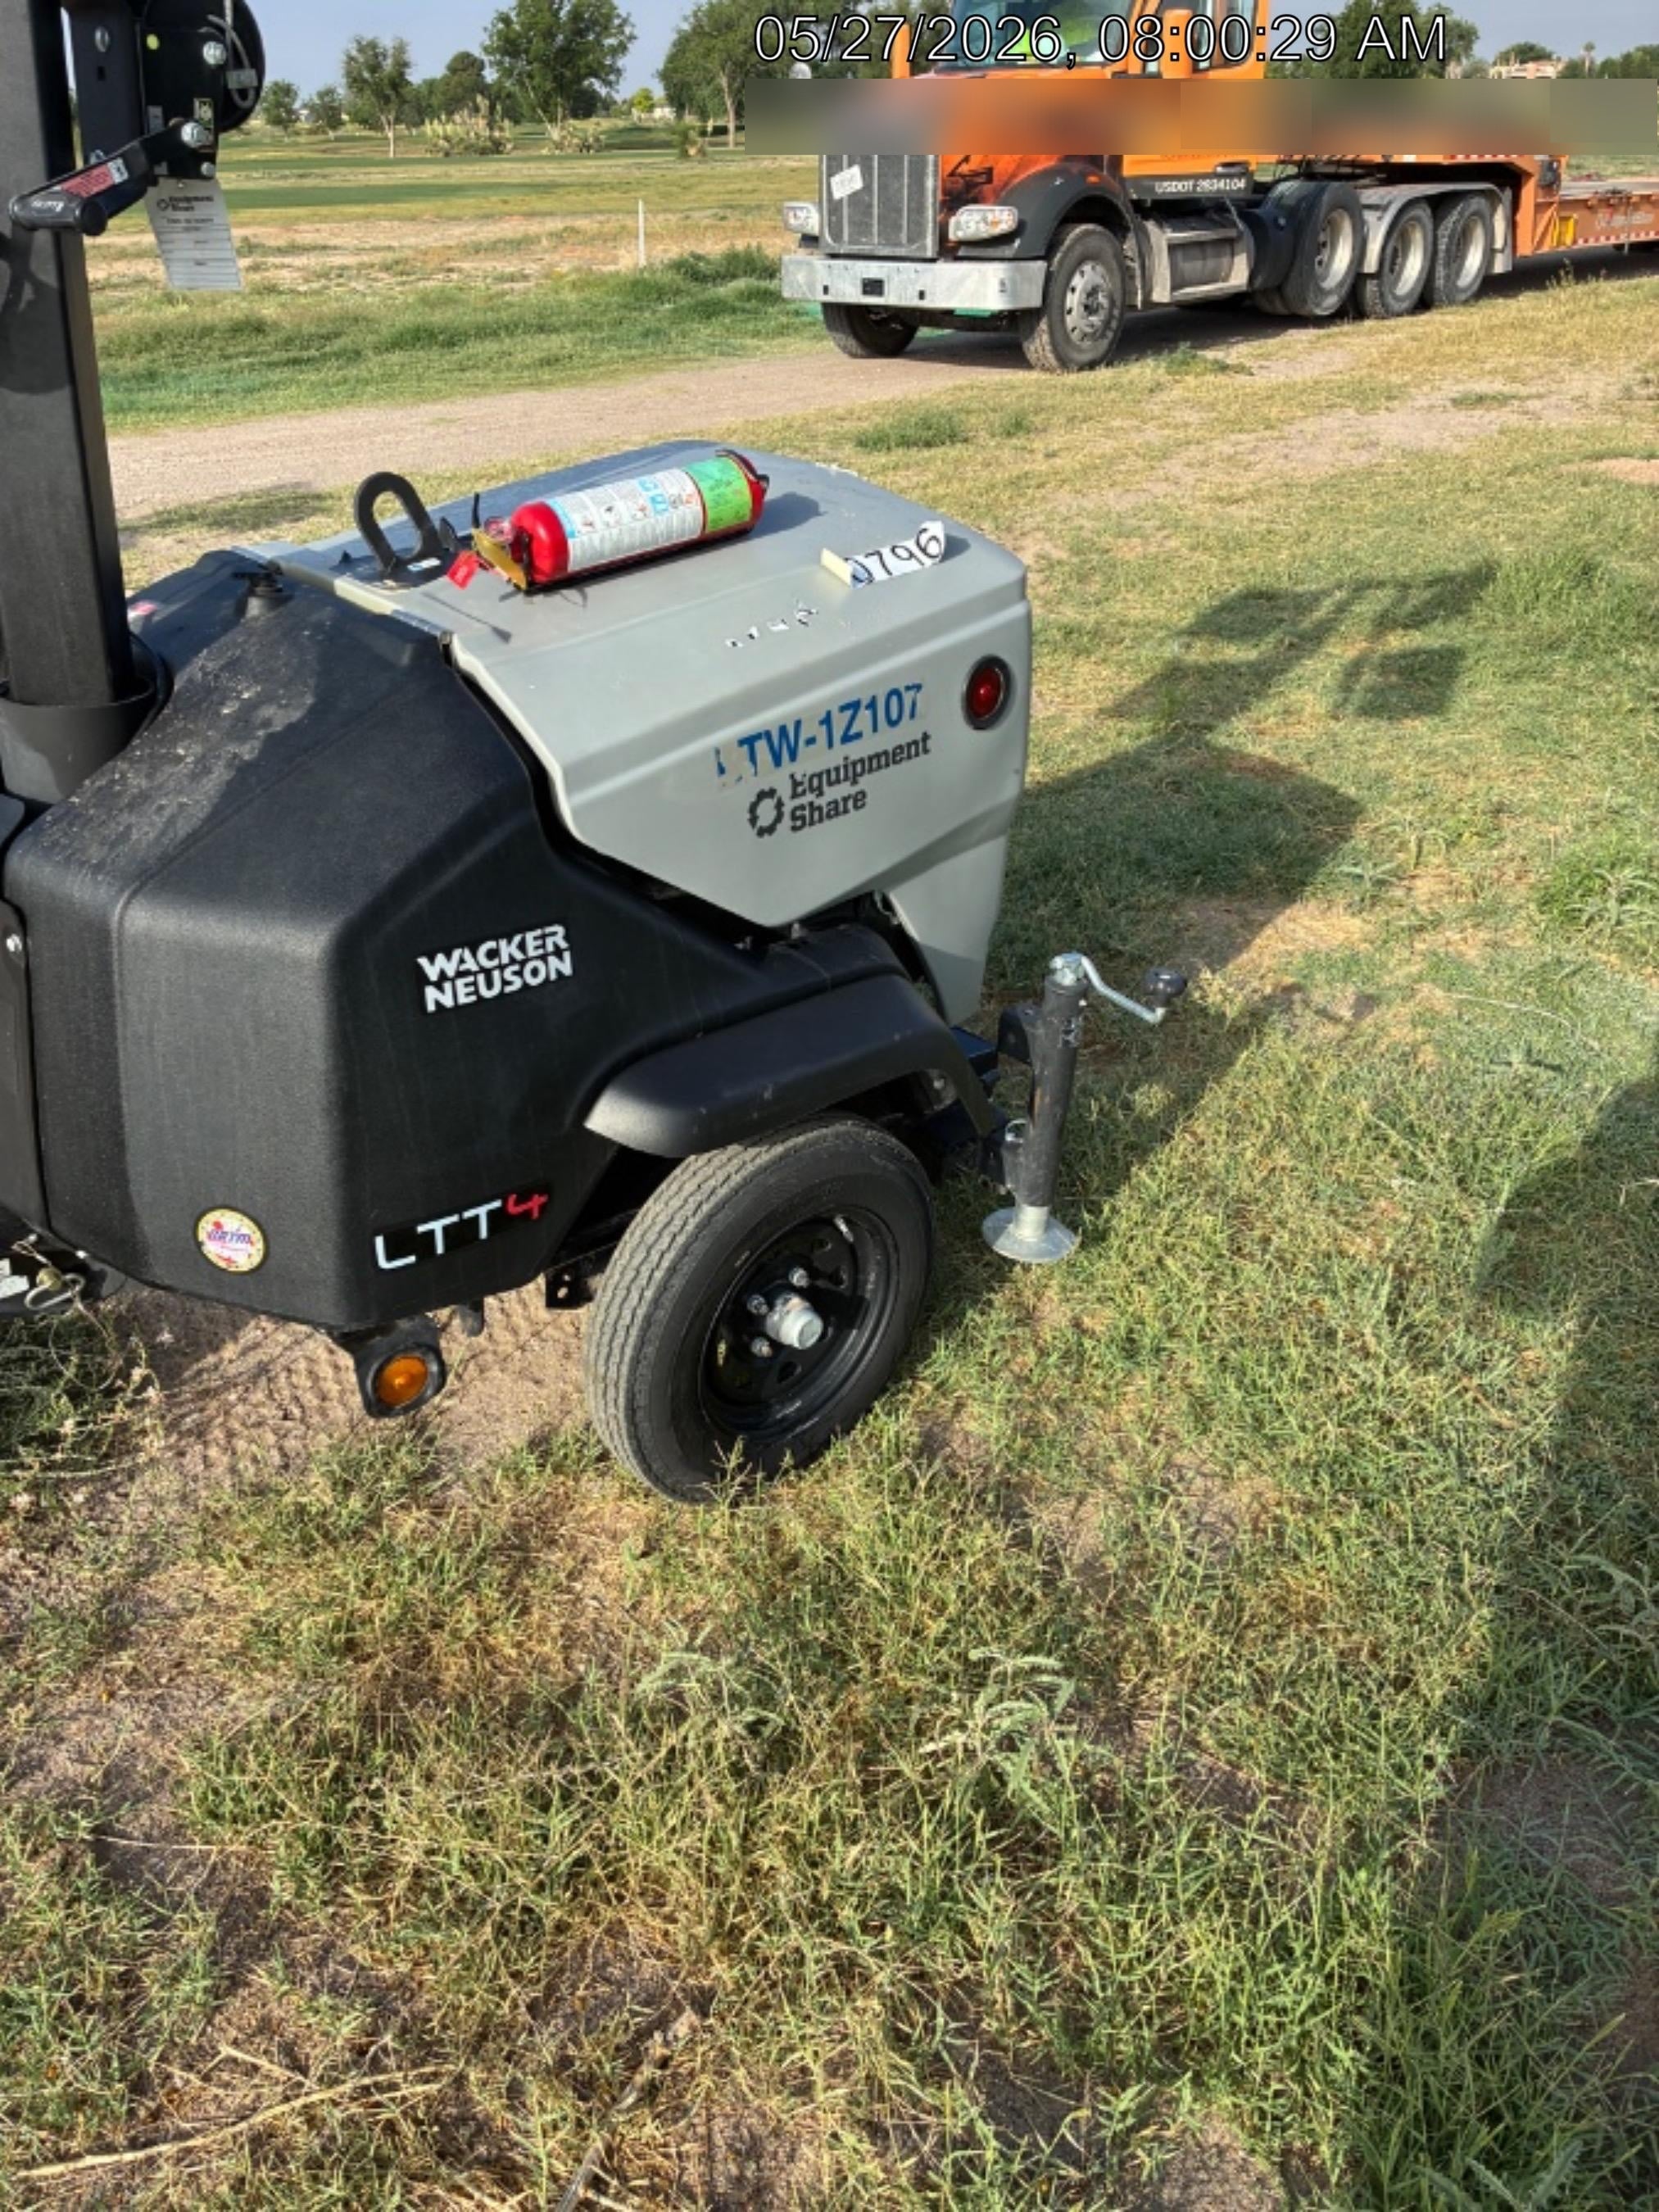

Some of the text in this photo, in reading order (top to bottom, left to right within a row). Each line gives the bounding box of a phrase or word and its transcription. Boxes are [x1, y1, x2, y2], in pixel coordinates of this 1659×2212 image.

[788, 731, 931, 800] Equipment
[790, 788, 868, 833] Share
[416, 923, 570, 981] WACKER
[424, 950, 573, 1013] NEUSON
[374, 1191, 549, 1270] LTT4
